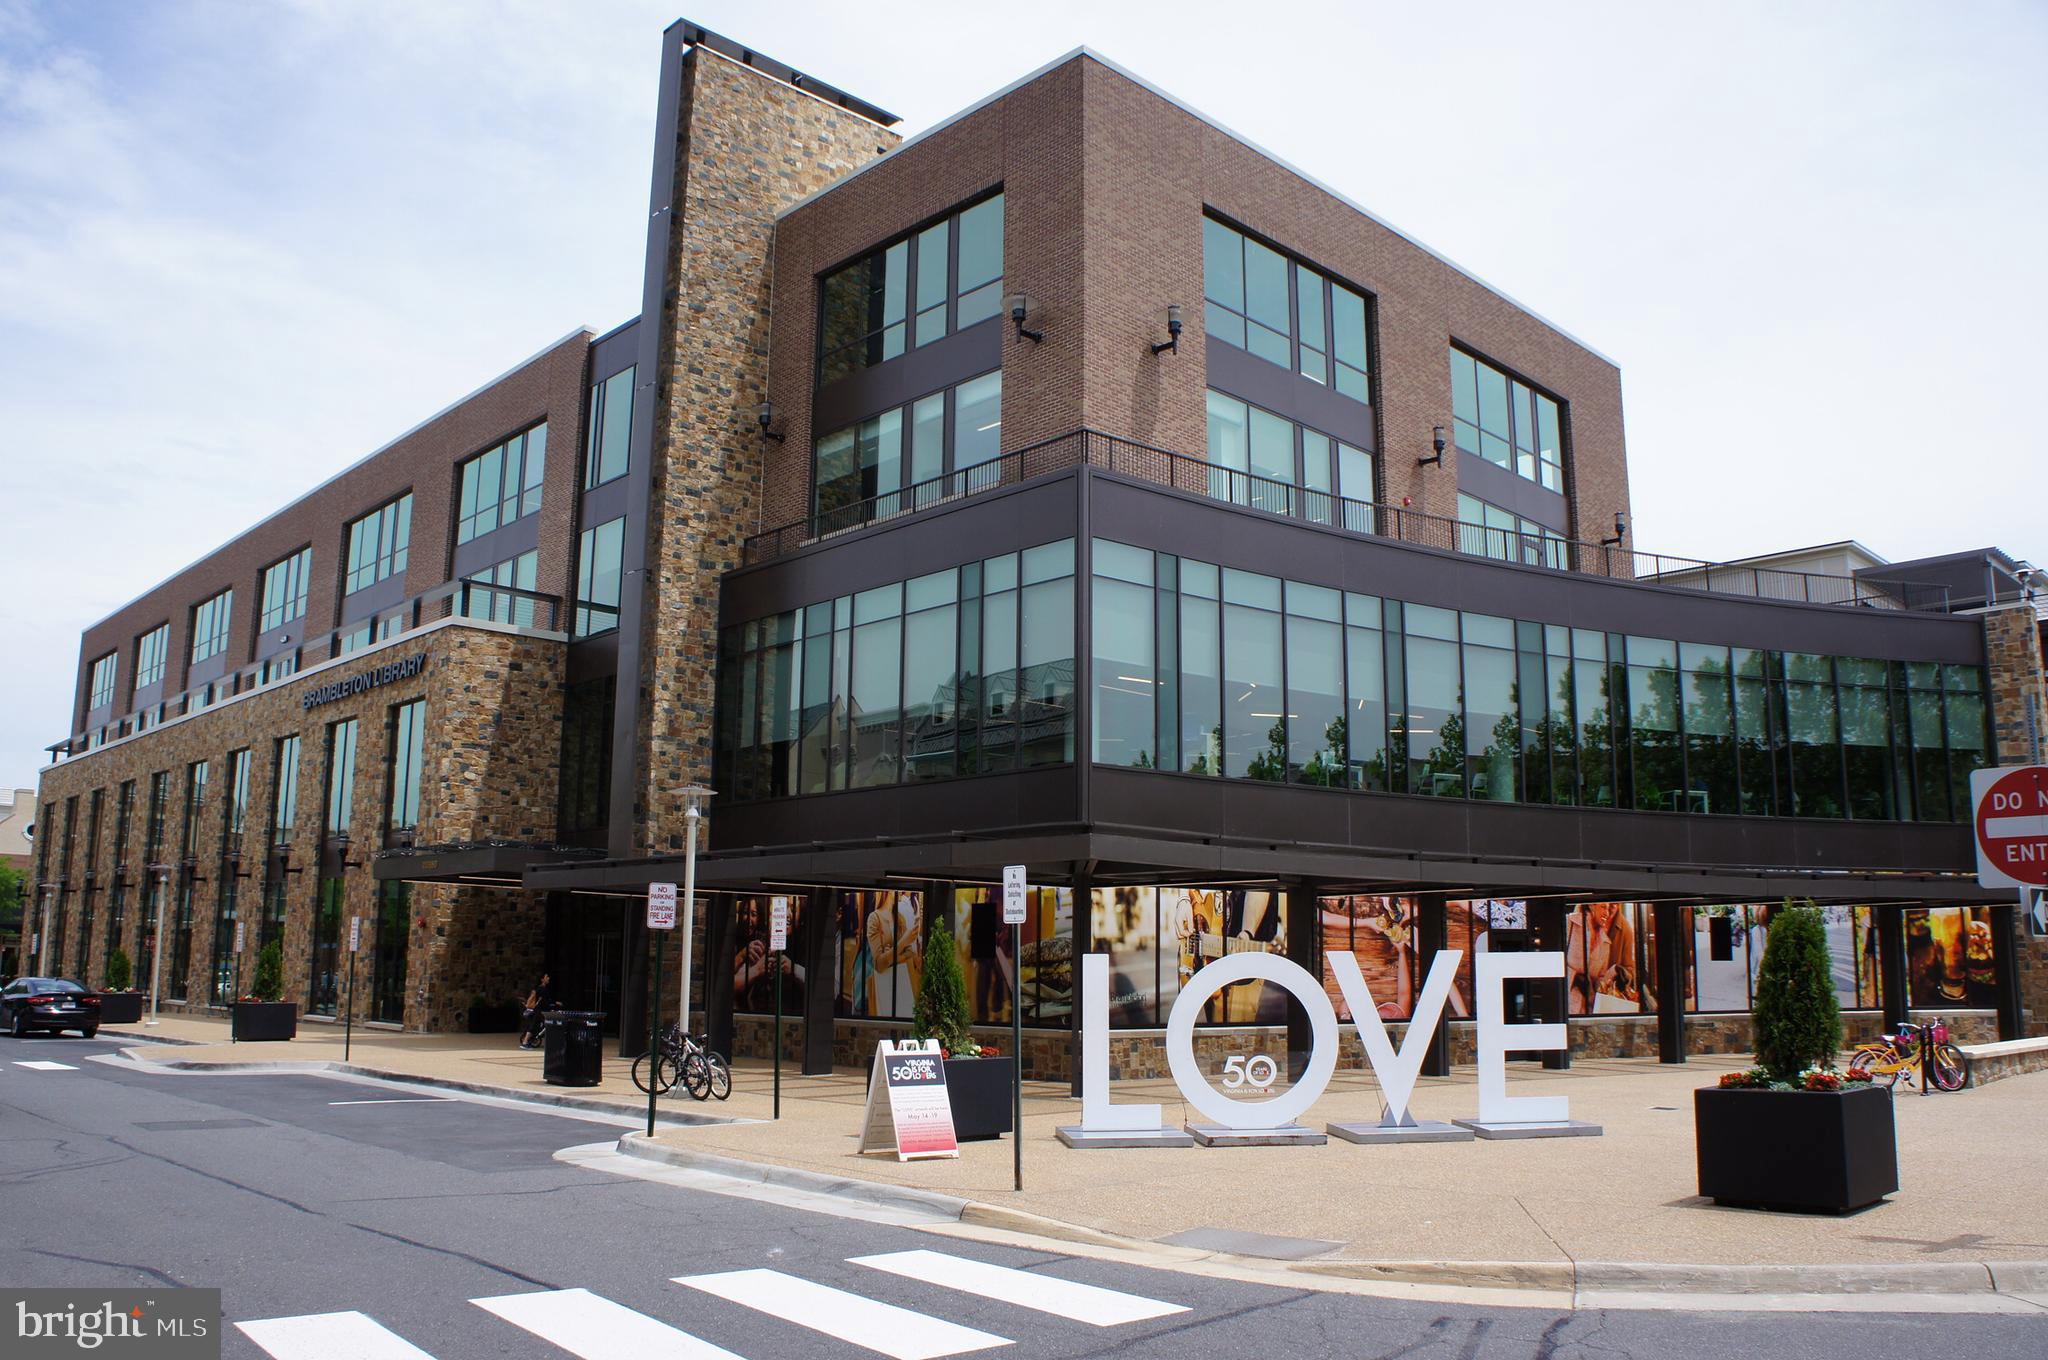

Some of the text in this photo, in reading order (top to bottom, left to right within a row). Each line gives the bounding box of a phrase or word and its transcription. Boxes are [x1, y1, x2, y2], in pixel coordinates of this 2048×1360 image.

[303, 653, 427, 710] BRAMBLETON LIBRARY
[1993, 792, 2022, 811] DO
[1082, 950, 1569, 1131] LOVE
[892, 1066, 912, 1080] 50
[1222, 1054, 1277, 1089] 50
